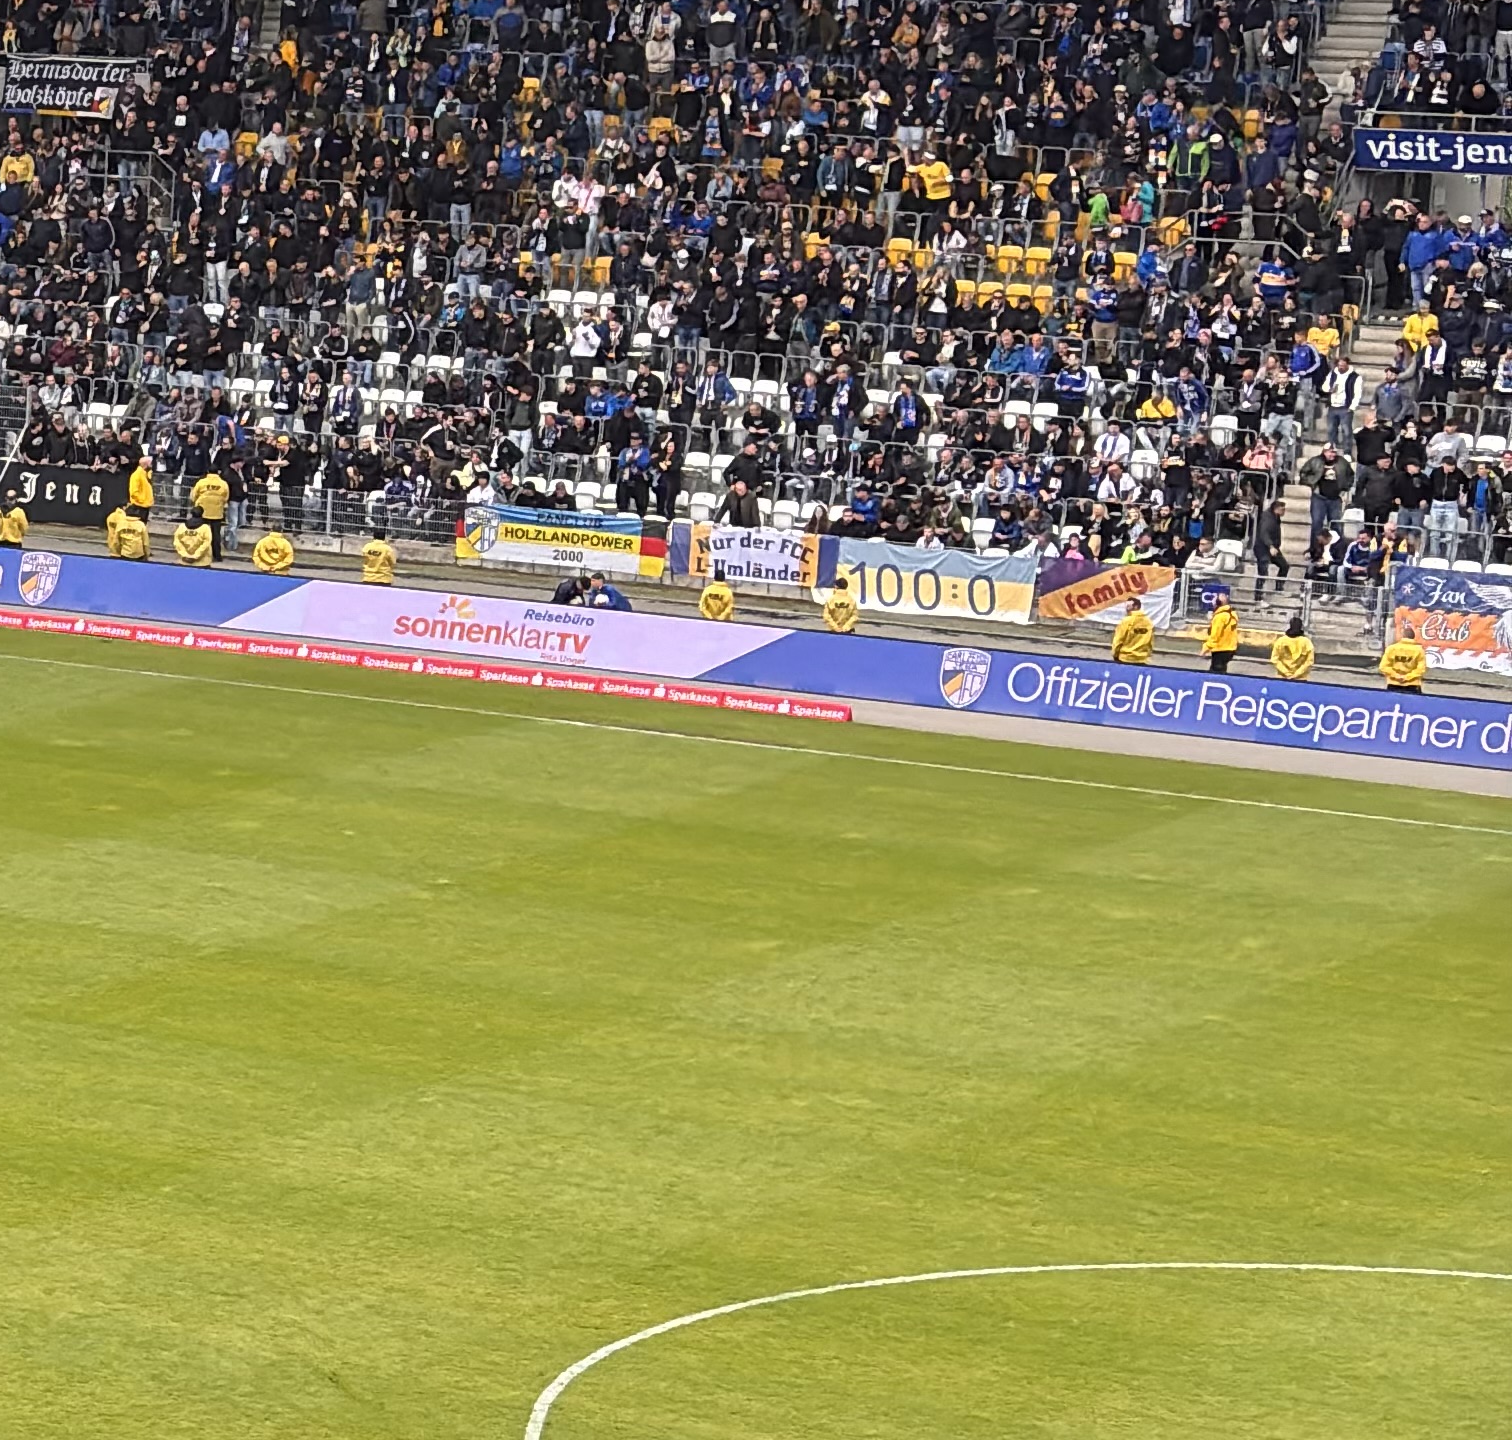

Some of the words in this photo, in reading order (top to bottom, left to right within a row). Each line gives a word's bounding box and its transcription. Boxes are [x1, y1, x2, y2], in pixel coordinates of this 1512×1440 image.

[504, 526, 633, 551] HOLZLANDPOWER
[552, 549, 584, 564] 2000
[697, 537, 735, 553] Nur
[740, 531, 775, 551] der
[778, 537, 815, 565] FCC
[851, 562, 997, 618] 100:0
[523, 608, 595, 627] Reisebüro
[87, 622, 130, 636] Sparkasse
[393, 614, 591, 654] sonnenklar.TV
[248, 642, 293, 657] Sparkasse
[426, 662, 474, 677] Sparkasse
[602, 680, 651, 697] Sparkasse
[793, 703, 844, 720] Sparkasse
[1008, 660, 1182, 718] Offizieller
[1196, 678, 1477, 750] Reisepartner
